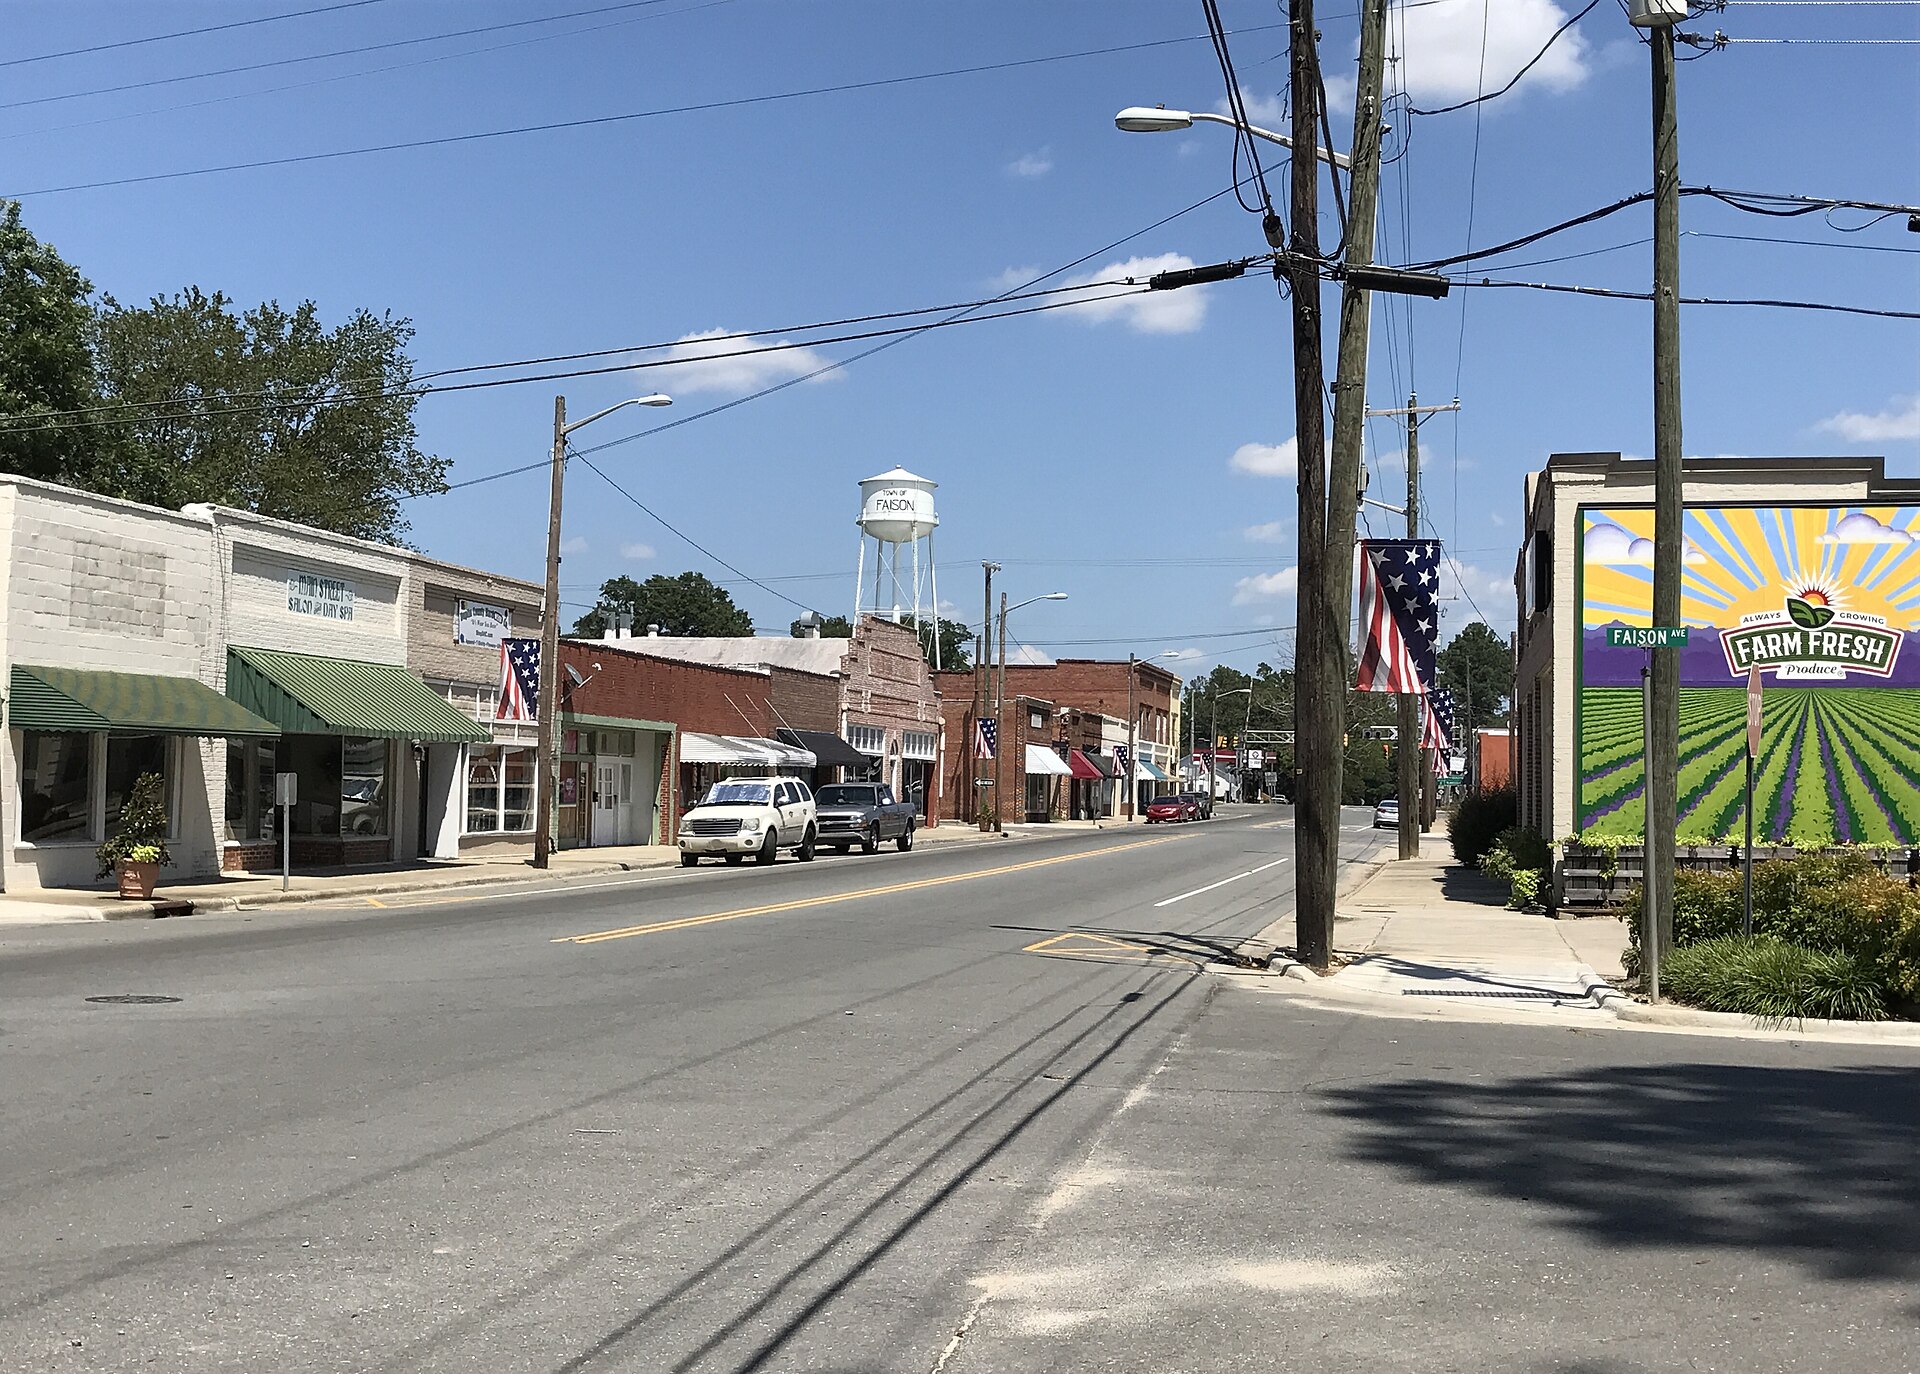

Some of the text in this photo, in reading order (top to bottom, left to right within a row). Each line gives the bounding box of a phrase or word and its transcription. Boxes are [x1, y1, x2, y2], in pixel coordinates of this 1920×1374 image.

[876, 499, 914, 511] FAISON
[298, 574, 345, 602] MAIN STREET
[288, 596, 313, 615] SALON
[323, 602, 339, 618] DAY
[340, 605, 353, 620] SPA
[1742, 612, 1885, 625] ALWAYS GROWING
[1613, 629, 1686, 645] FAISON AVE
[1735, 631, 1887, 664] FARM FRESH
